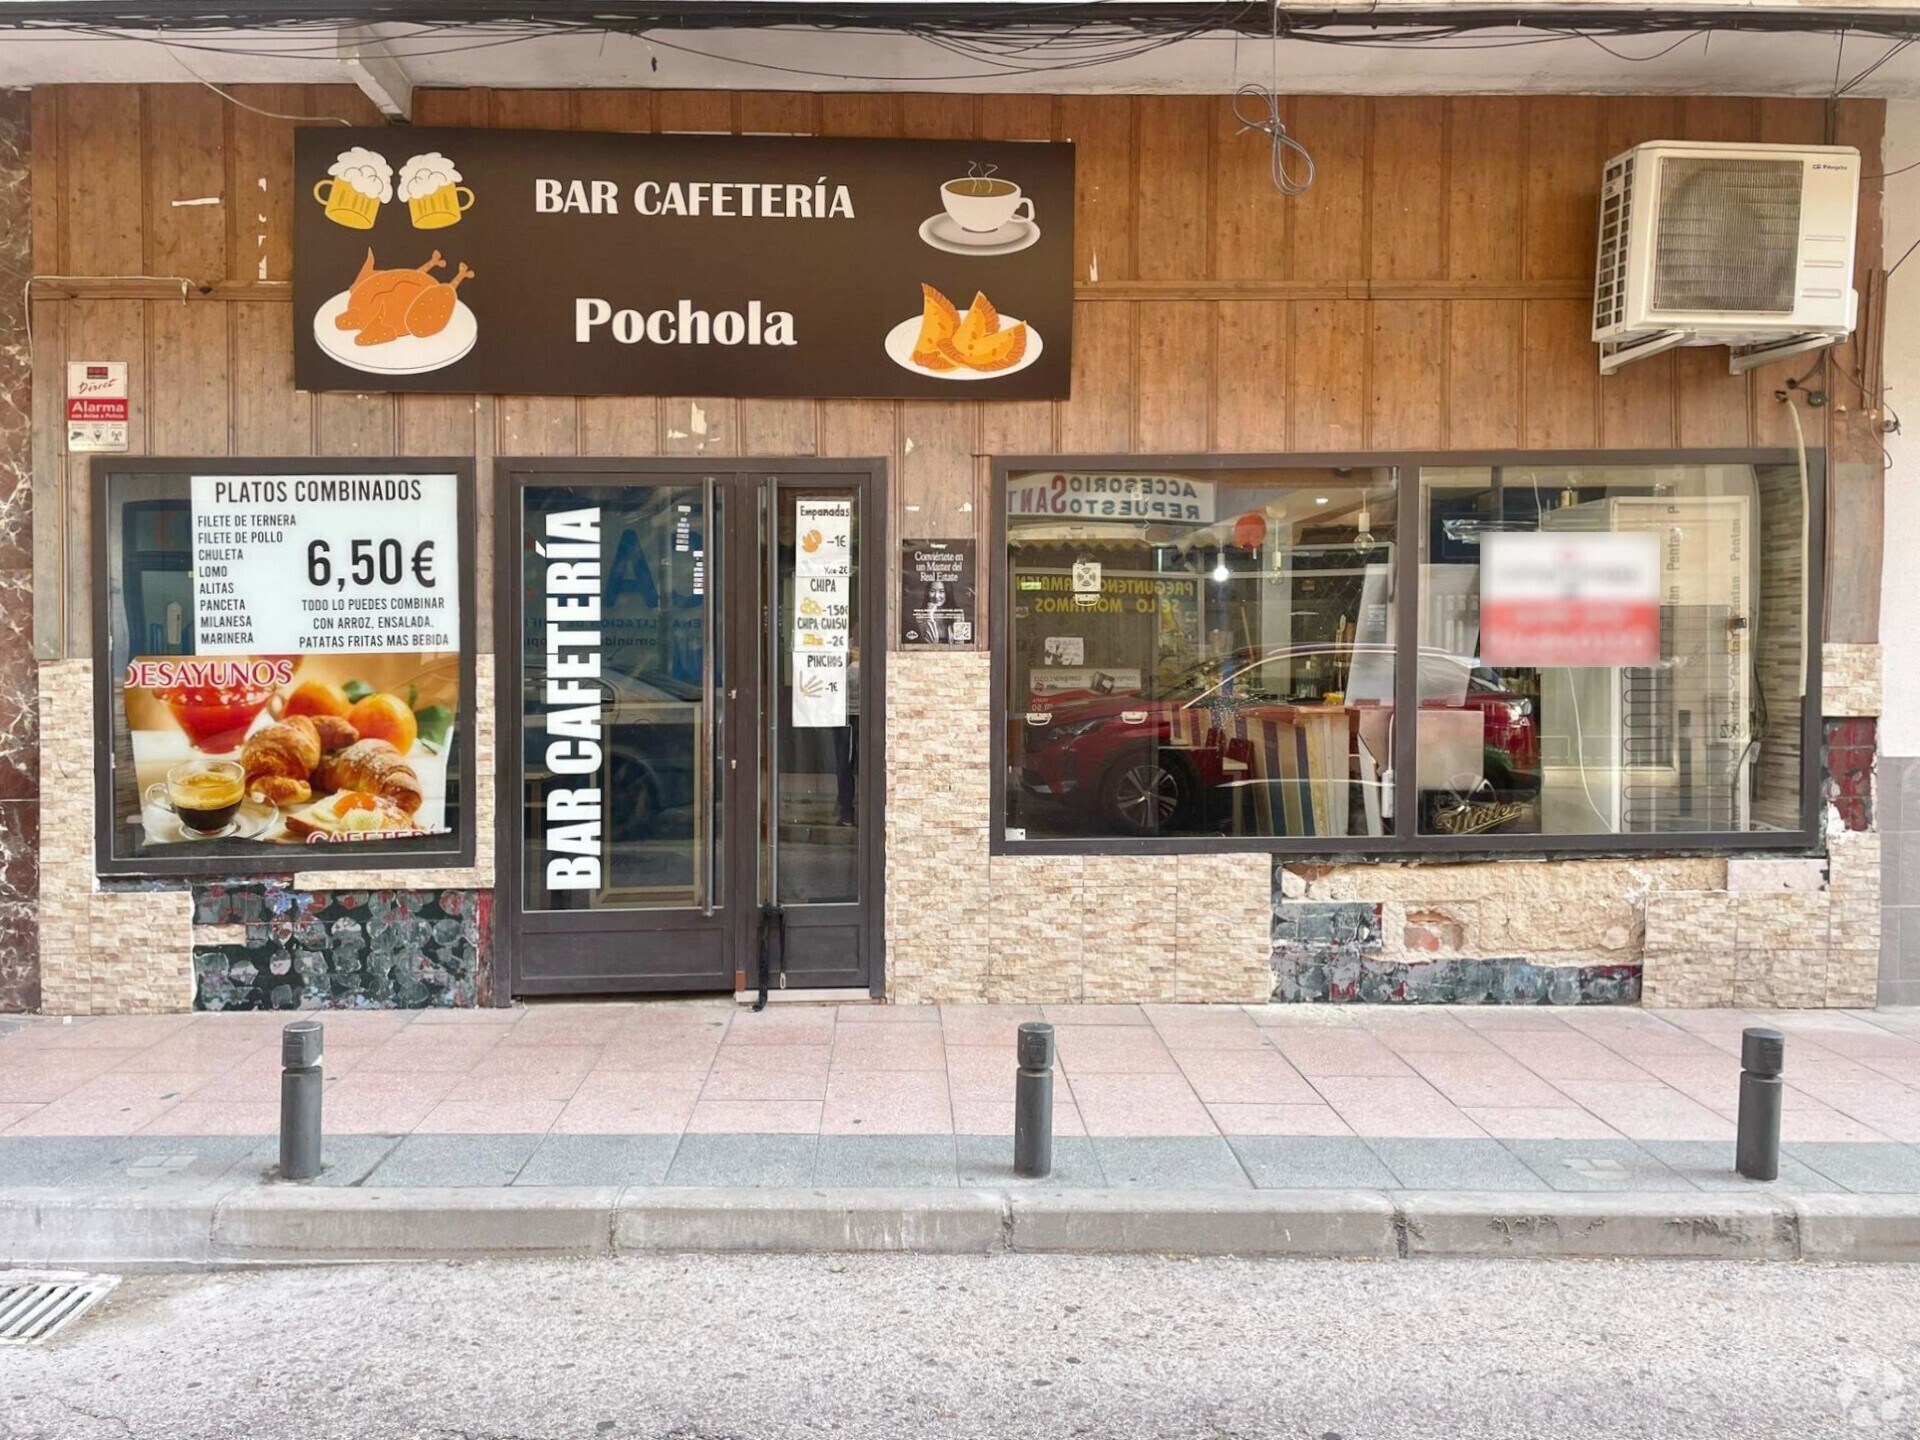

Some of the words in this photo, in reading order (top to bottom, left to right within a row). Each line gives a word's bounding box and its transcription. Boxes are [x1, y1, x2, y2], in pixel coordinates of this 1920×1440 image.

[535, 178, 619, 214] BAR
[634, 176, 855, 218] CAFETERÍA
[575, 298, 798, 346] Pochola
[72, 400, 124, 413] Alarma
[216, 481, 287, 503] PLATOS
[295, 479, 421, 502] COMBINADOS
[800, 504, 850, 520] Empanadas
[198, 515, 231, 527] FILETE
[234, 514, 247, 526] DE
[250, 514, 297, 526] TERNERA
[198, 532, 231, 544] FILETE
[235, 531, 247, 543] DE
[251, 531, 283, 543] POLLO
[1730, 518, 1741, 562] Pentan
[198, 548, 243, 561] CHULETA
[914, 551, 954, 562] Conviértete
[955, 553, 964, 562] en
[199, 565, 228, 578] LOMO
[915, 564, 926, 572] un
[951, 561, 963, 572] del
[920, 571, 936, 582] Real
[936, 571, 959, 582] Estate
[199, 582, 234, 594] ALITAS
[810, 578, 837, 592] CHIPA
[200, 599, 246, 611] PANCETA
[302, 599, 328, 611] TODO
[332, 599, 345, 611] LO
[348, 598, 387, 610] PUEDES
[390, 597, 445, 610] COMBINAR
[200, 615, 252, 628] MILANESA
[313, 617, 334, 630] CON
[201, 631, 254, 645] MARINERA
[299, 635, 344, 648] PATATAS
[348, 634, 383, 648] FRITAS
[386, 634, 409, 647] MAS
[412, 633, 449, 646] BEBIDA
[535, 506, 602, 775] CAFETERÍA
[807, 654, 843, 668] PINCHOS
[546, 787, 602, 891] BAR
